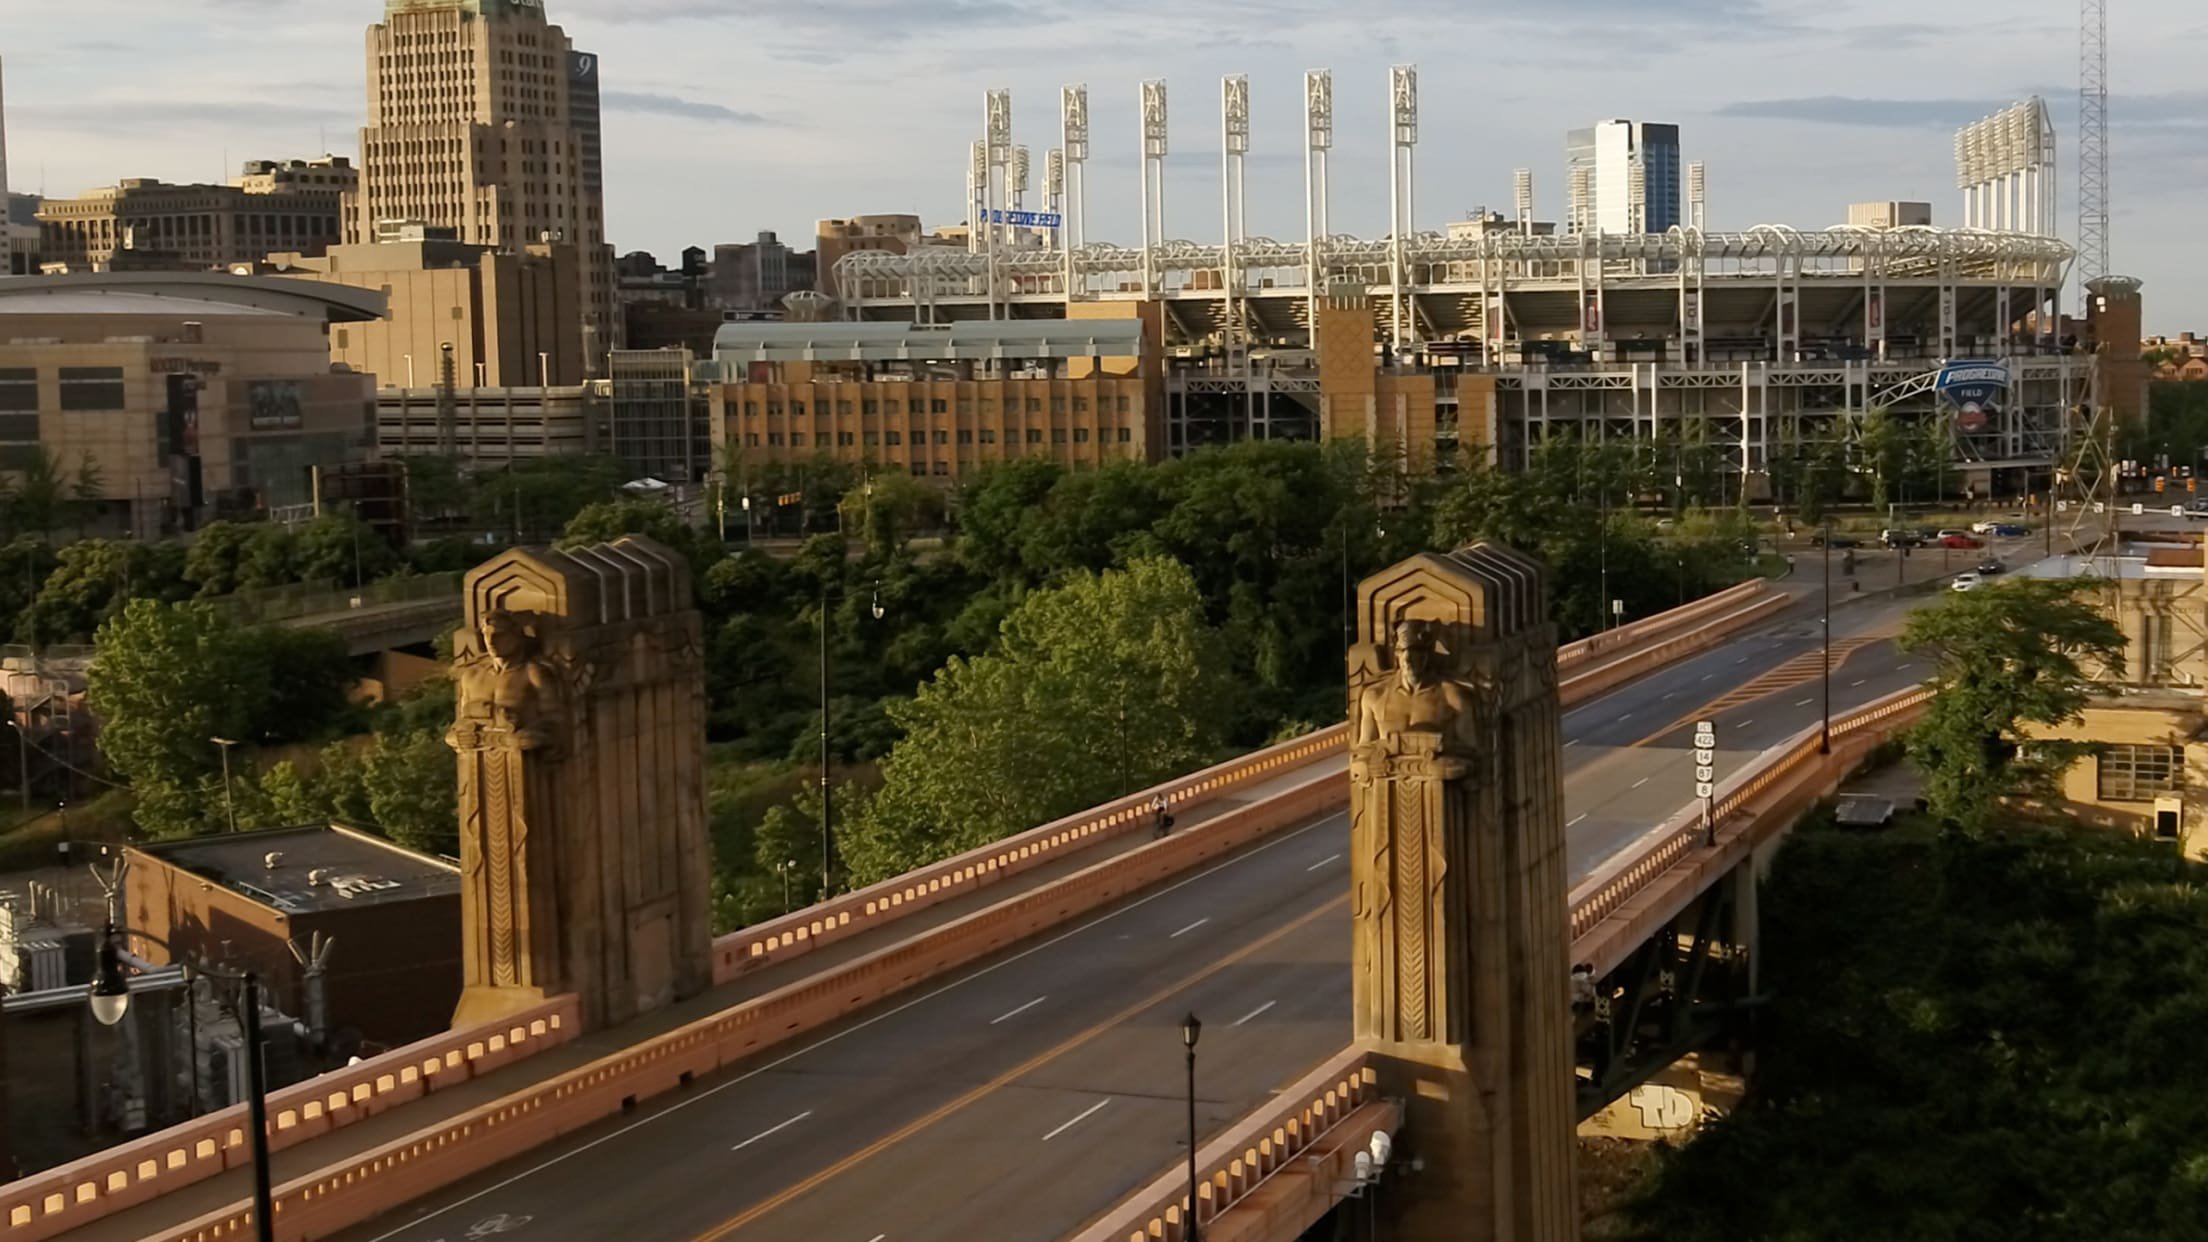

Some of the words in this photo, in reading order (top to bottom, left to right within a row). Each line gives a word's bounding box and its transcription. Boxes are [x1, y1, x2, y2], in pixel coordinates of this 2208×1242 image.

[576, 55, 591, 76] 9
[1961, 389, 1983, 397] FIELD
[1697, 735, 1713, 745] 422
[1700, 751, 1710, 761] 14
[1698, 768, 1711, 778] 87
[1701, 785, 1708, 795] 8
